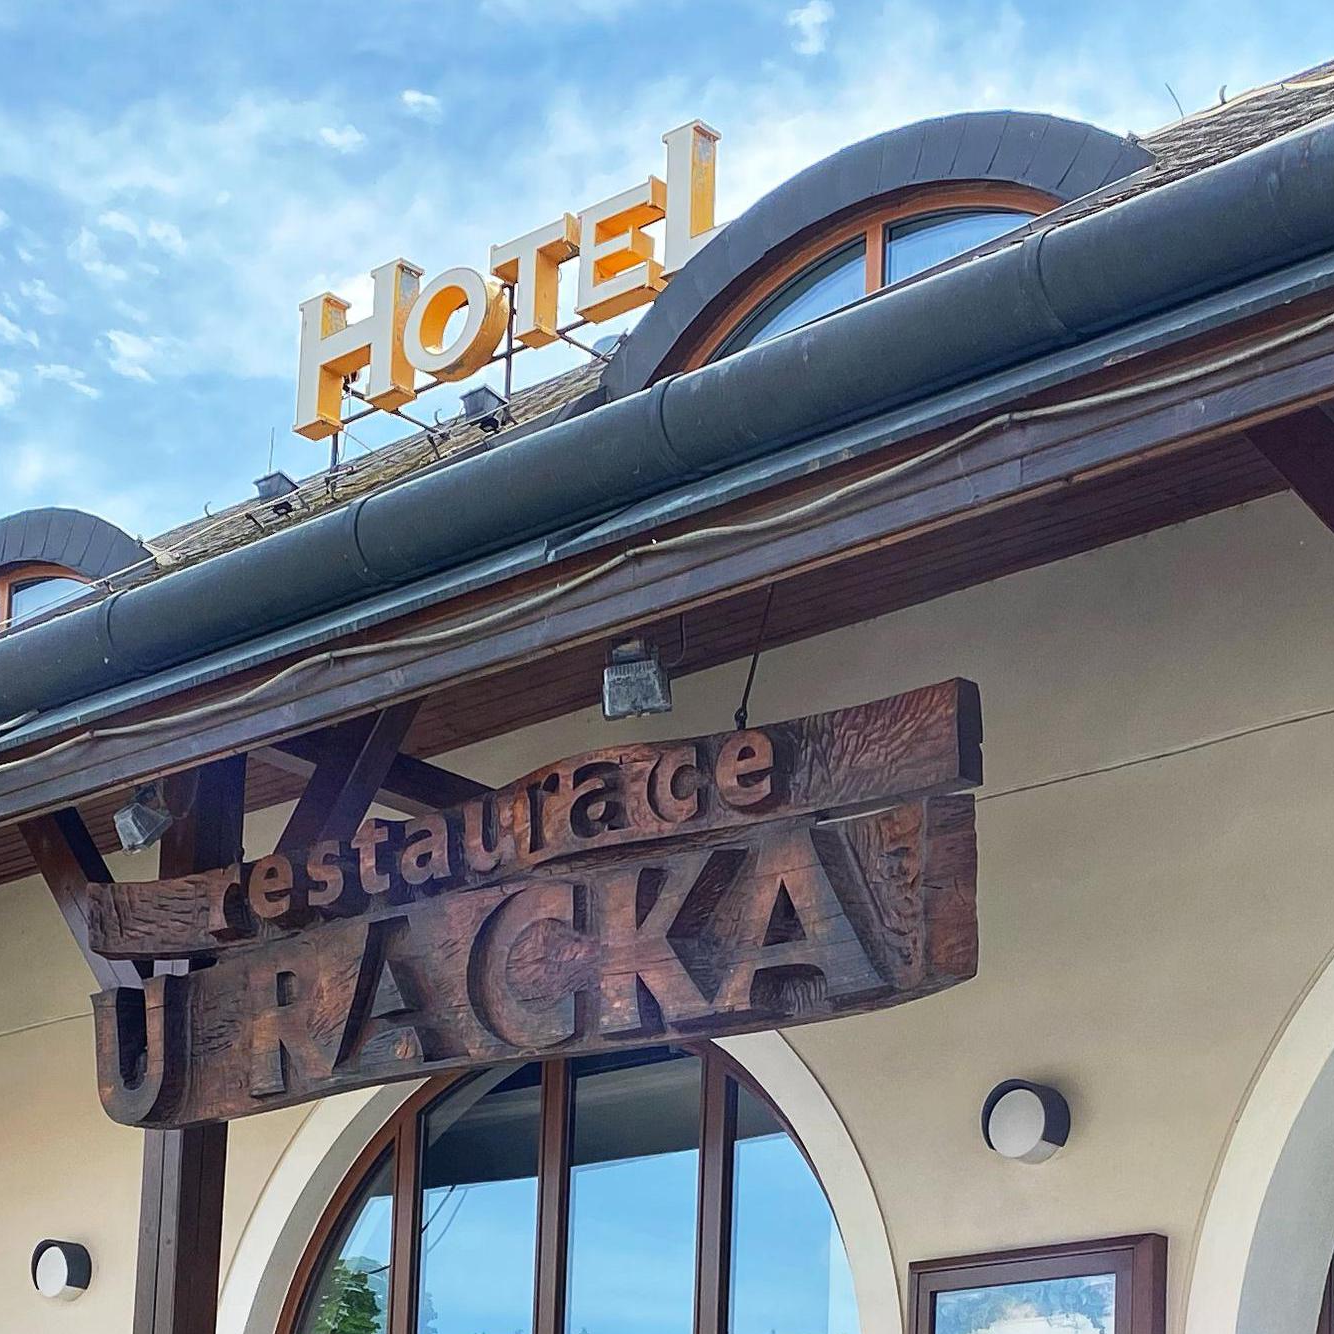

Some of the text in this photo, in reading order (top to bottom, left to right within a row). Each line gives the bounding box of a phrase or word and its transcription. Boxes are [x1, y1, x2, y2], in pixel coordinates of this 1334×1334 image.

[293, 118, 731, 442] HOTEL
[208, 729, 775, 930] restaurace
[91, 972, 167, 1128] U
